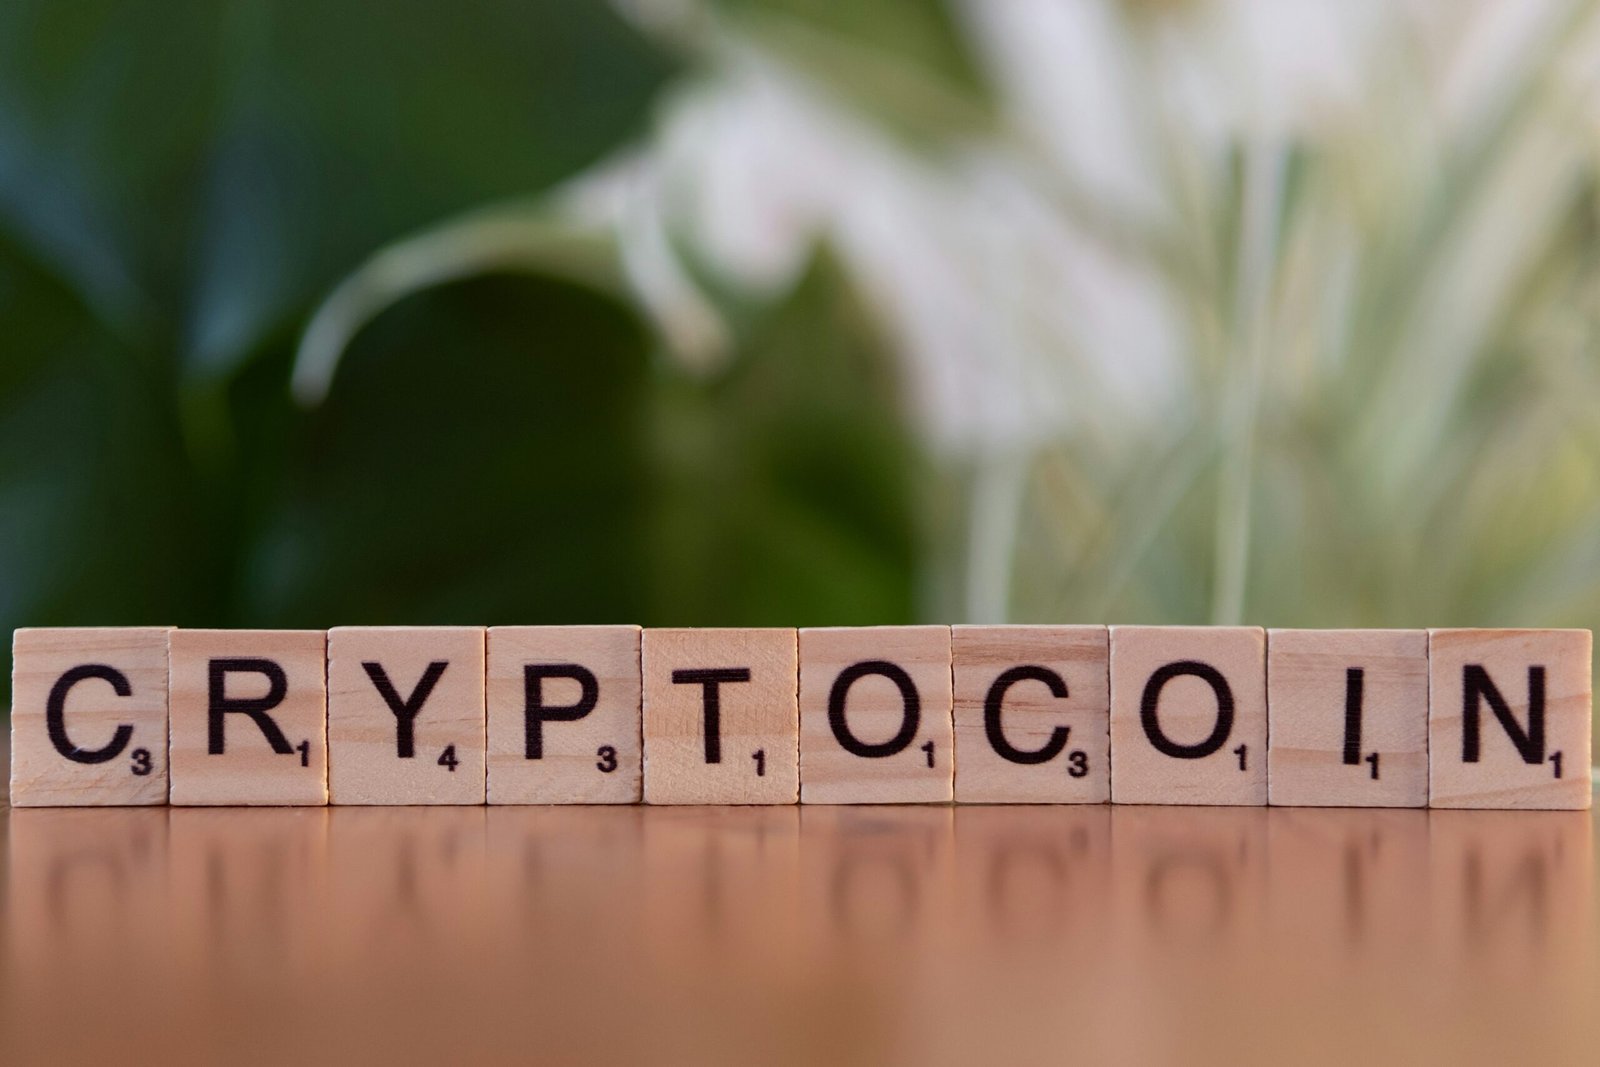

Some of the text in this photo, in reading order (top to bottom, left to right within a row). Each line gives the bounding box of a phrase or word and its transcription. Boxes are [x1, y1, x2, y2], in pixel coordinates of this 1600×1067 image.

[45, 657, 1547, 767] CRYPTOCOIN
[130, 747, 154, 777] 3
[295, 739, 310, 768] 1
[437, 744, 460, 772] 4
[596, 745, 618, 774] 3
[751, 749, 766, 777] 1
[920, 740, 936, 769] 1
[1067, 750, 1090, 779] 3
[1233, 743, 1248, 772] 1
[1364, 752, 1380, 781] 1
[1548, 750, 1563, 779] 1
